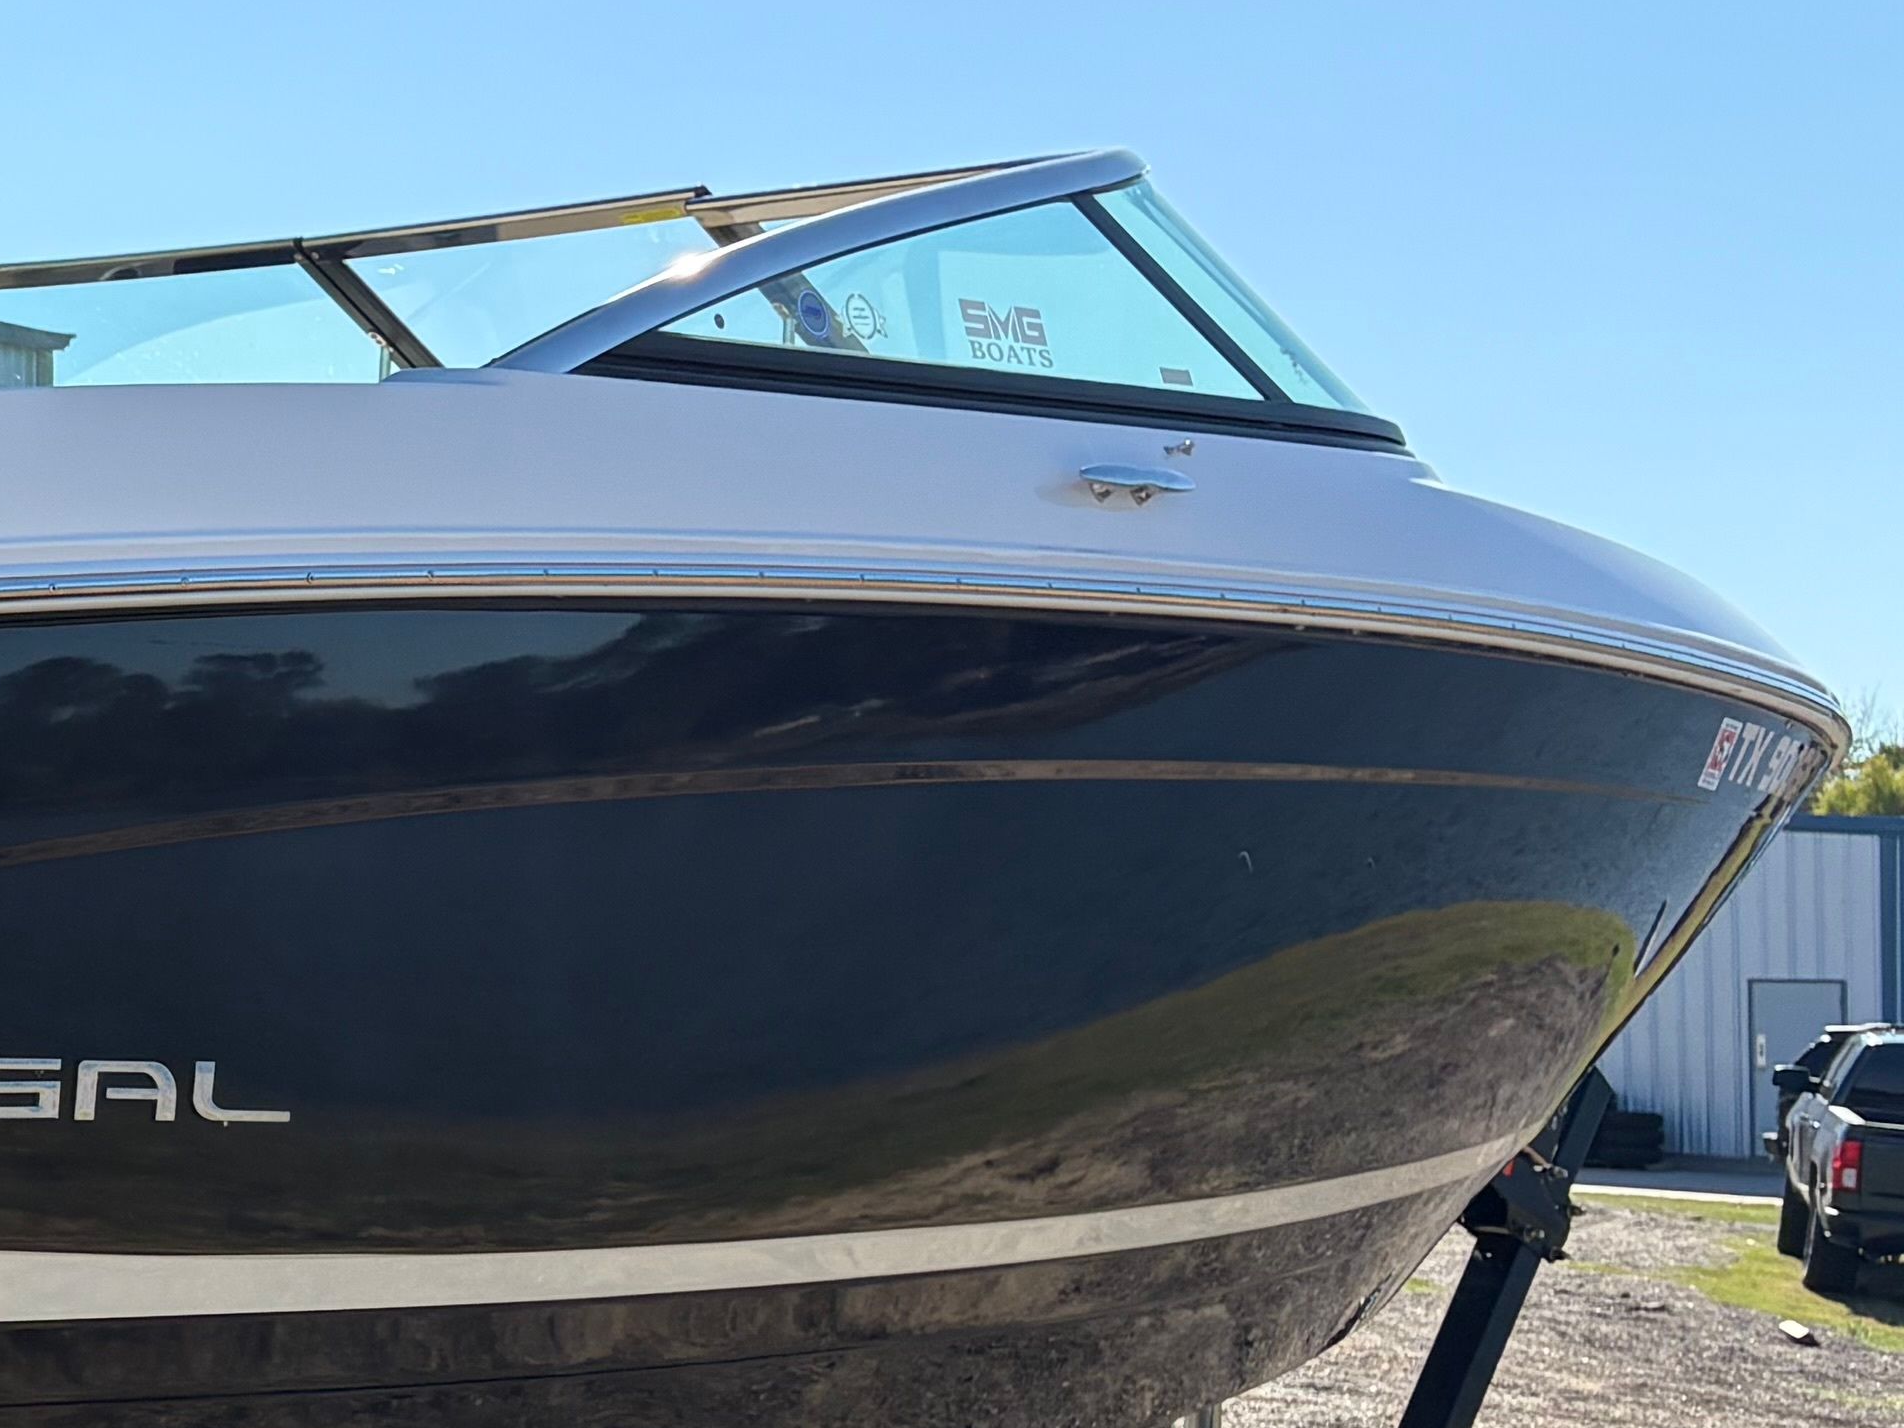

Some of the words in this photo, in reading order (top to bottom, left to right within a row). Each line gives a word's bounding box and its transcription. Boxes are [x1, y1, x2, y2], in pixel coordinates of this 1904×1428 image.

[958, 298, 1048, 347] SMG
[969, 339, 1054, 368] BOATS
[1728, 722, 1775, 787] TX
